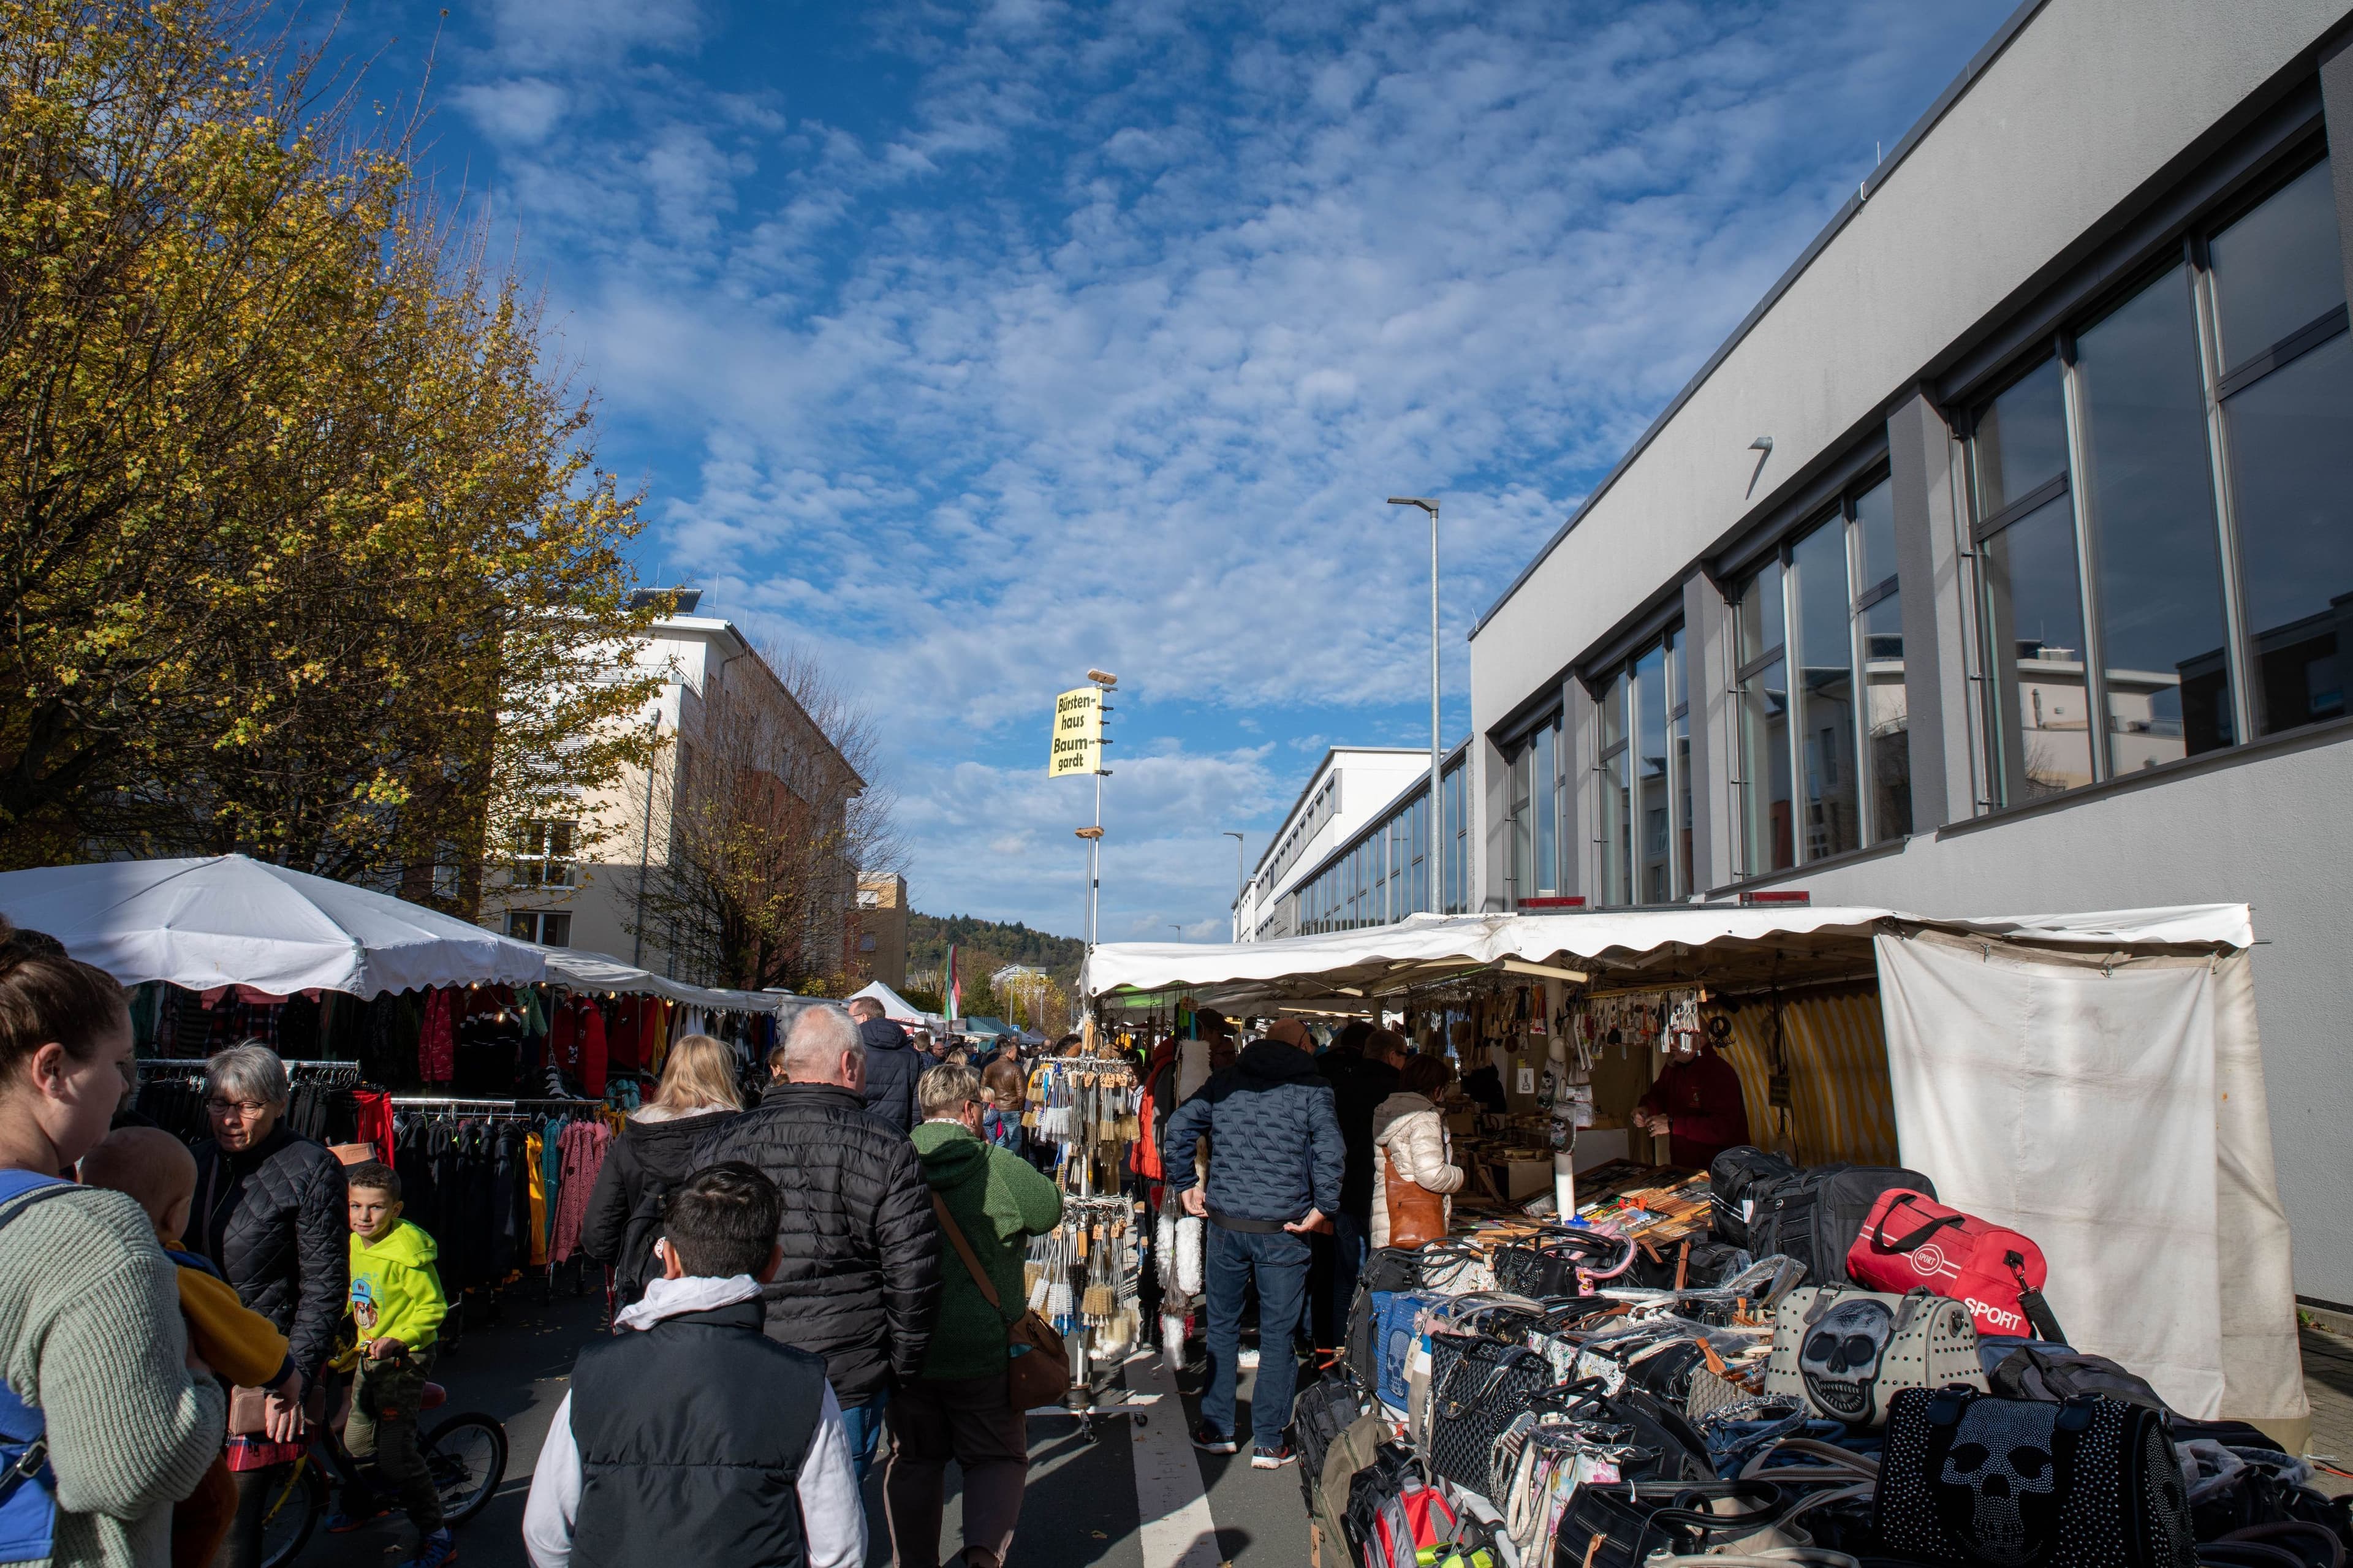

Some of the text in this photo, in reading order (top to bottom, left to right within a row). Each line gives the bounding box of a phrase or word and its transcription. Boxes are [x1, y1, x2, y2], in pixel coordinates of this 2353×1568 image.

[1058, 695, 1096, 713] Bürsten-
[1061, 715, 1084, 730] haus
[1054, 738, 1095, 754] Baum-
[1058, 752, 1083, 771] gardt
[1918, 1253, 1936, 1266] SPORT
[1965, 1297, 2021, 1331] SPORT
